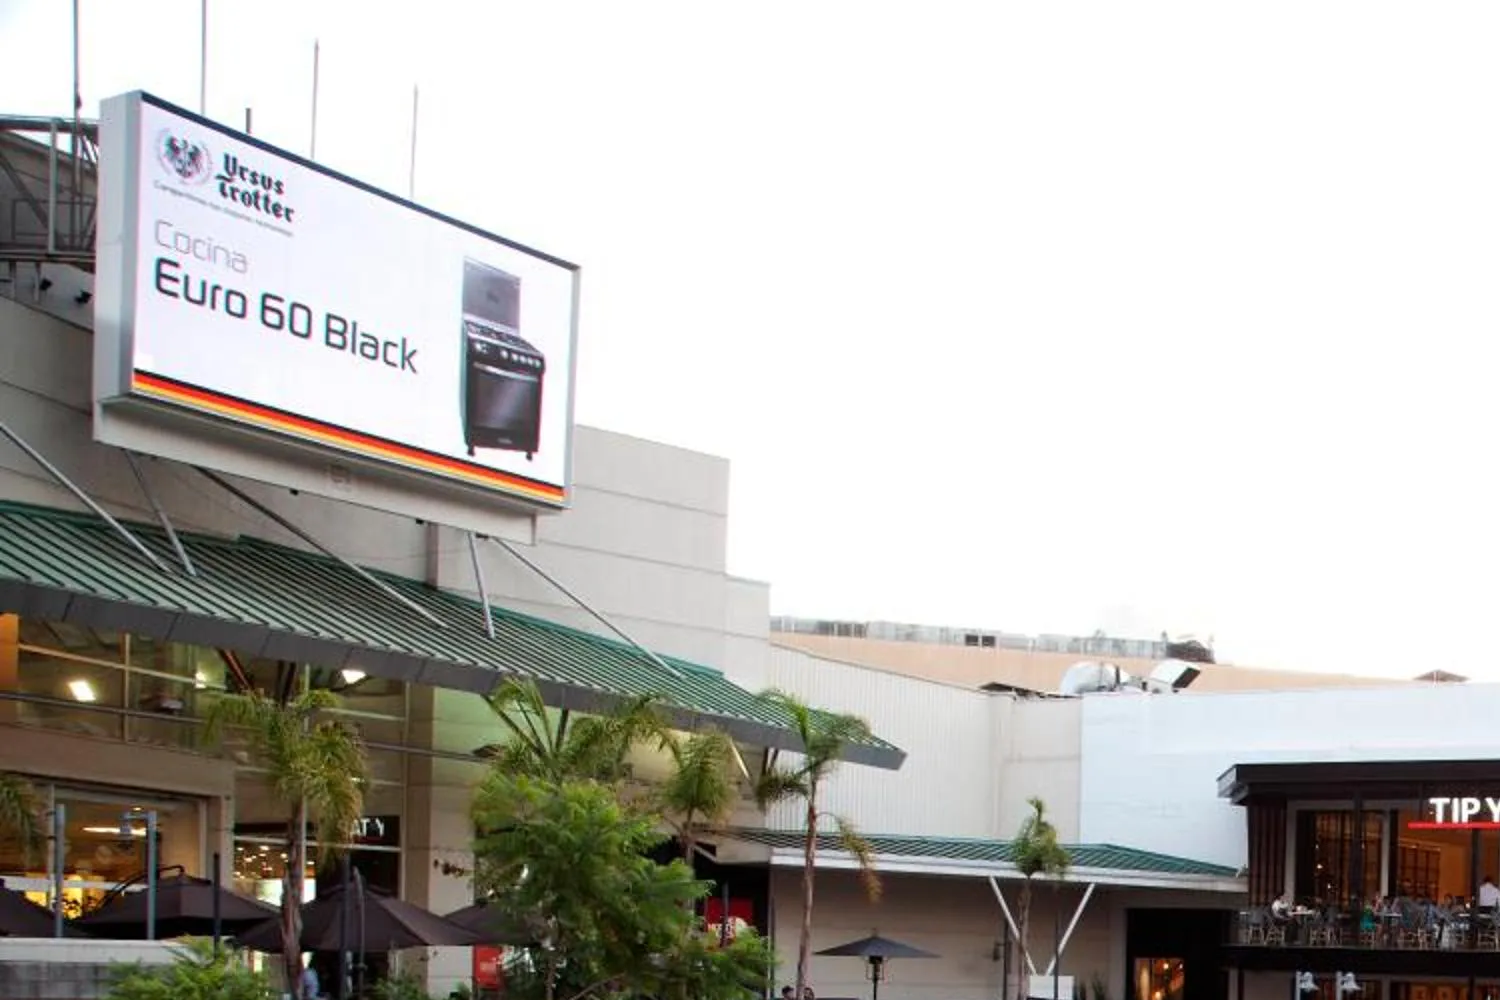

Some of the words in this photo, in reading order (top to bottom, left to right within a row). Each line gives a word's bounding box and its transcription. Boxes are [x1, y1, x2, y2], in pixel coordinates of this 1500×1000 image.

[215, 174, 295, 222] Trotter
[223, 153, 284, 195] Ursus
[154, 219, 249, 275] Cocina
[154, 256, 248, 319] Euro
[260, 292, 312, 340] 60
[324, 312, 420, 375] Black
[1429, 797, 1482, 823] TIP
